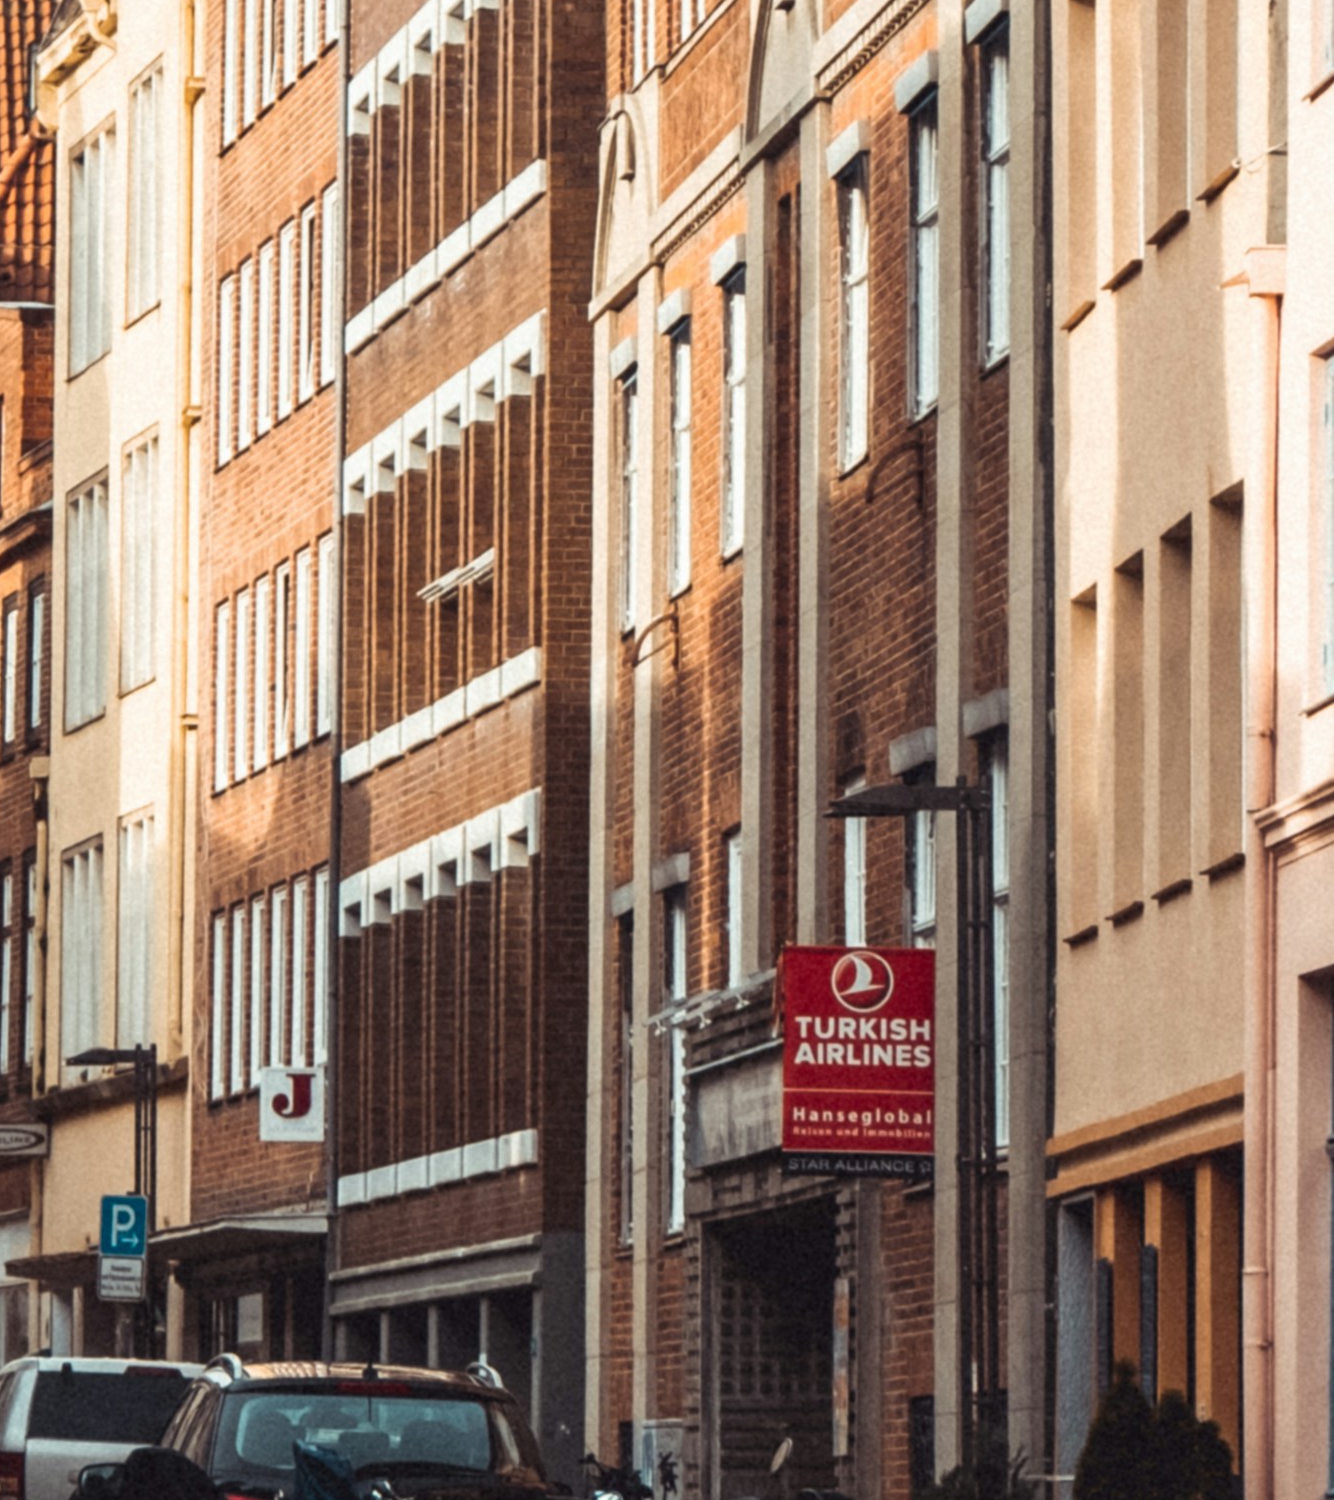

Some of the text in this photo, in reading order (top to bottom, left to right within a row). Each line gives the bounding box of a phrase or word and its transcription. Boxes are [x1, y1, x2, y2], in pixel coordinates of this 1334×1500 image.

[795, 1016, 930, 1040] TURKISH
[794, 1043, 931, 1067] AIRLINES
[272, 1073, 316, 1118] J
[793, 1106, 931, 1126] Hanseglobal
[793, 1127, 931, 1138] Reisen und Immobilien
[788, 1158, 915, 1173] STAR ALLIANCE
[110, 1204, 136, 1248] P
